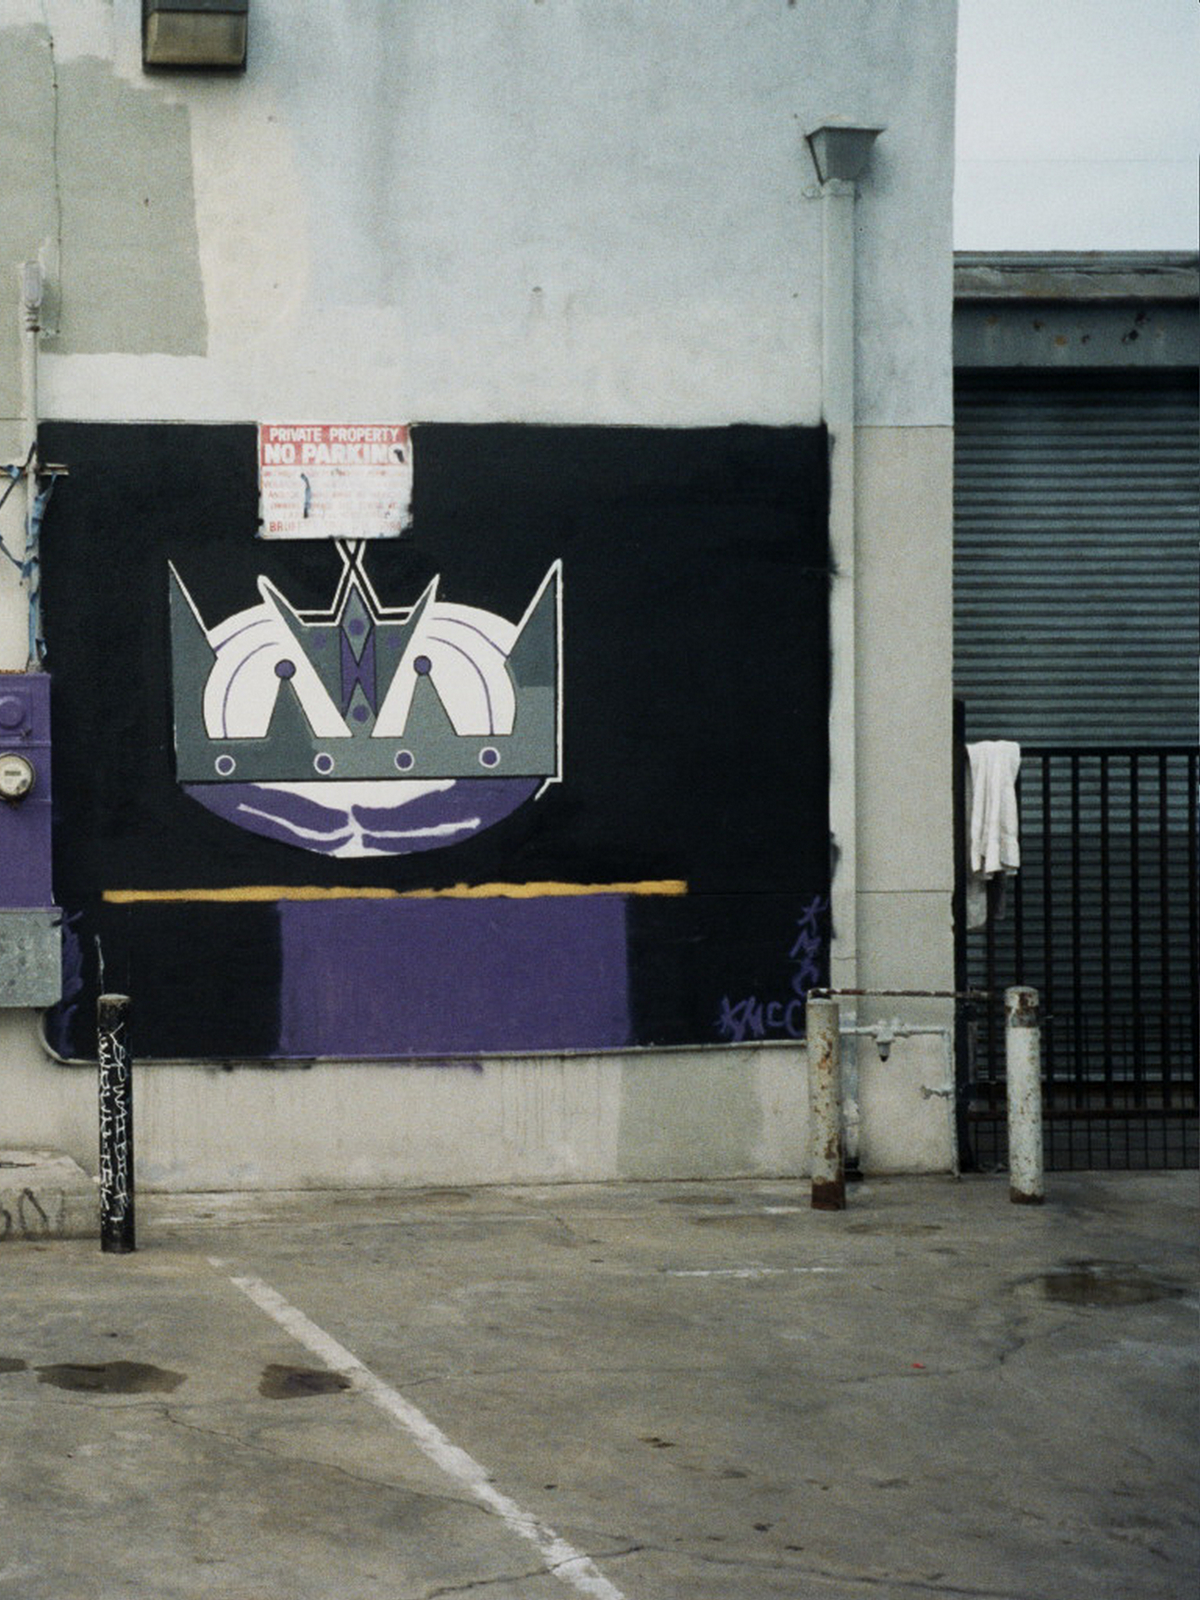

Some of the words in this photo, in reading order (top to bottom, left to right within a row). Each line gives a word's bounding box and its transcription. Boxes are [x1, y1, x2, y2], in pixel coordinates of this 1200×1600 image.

[269, 427, 323, 442] PRIVATE
[329, 427, 400, 442] PROPERTY
[264, 443, 296, 465] NO
[302, 443, 407, 465] PARKING
